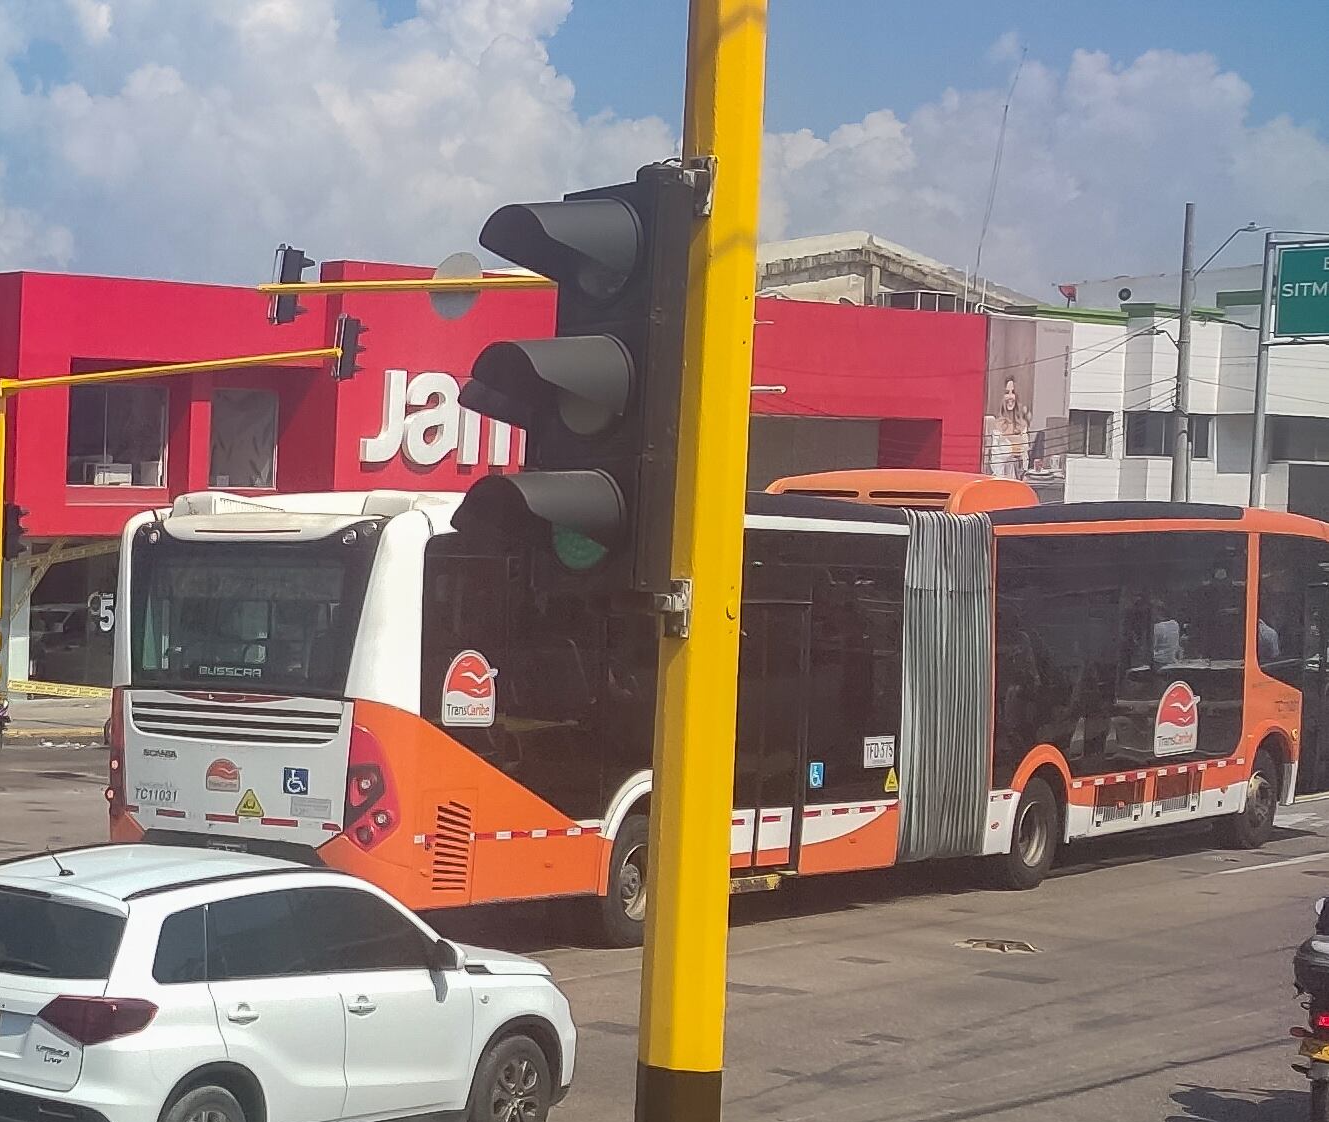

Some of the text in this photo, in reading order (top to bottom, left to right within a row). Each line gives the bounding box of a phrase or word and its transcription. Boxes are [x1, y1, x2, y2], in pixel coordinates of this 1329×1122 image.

[1282, 282, 1328, 297] SITM
[446, 703, 490, 717] TransCaribe
[135, 787, 178, 802] TC11031
